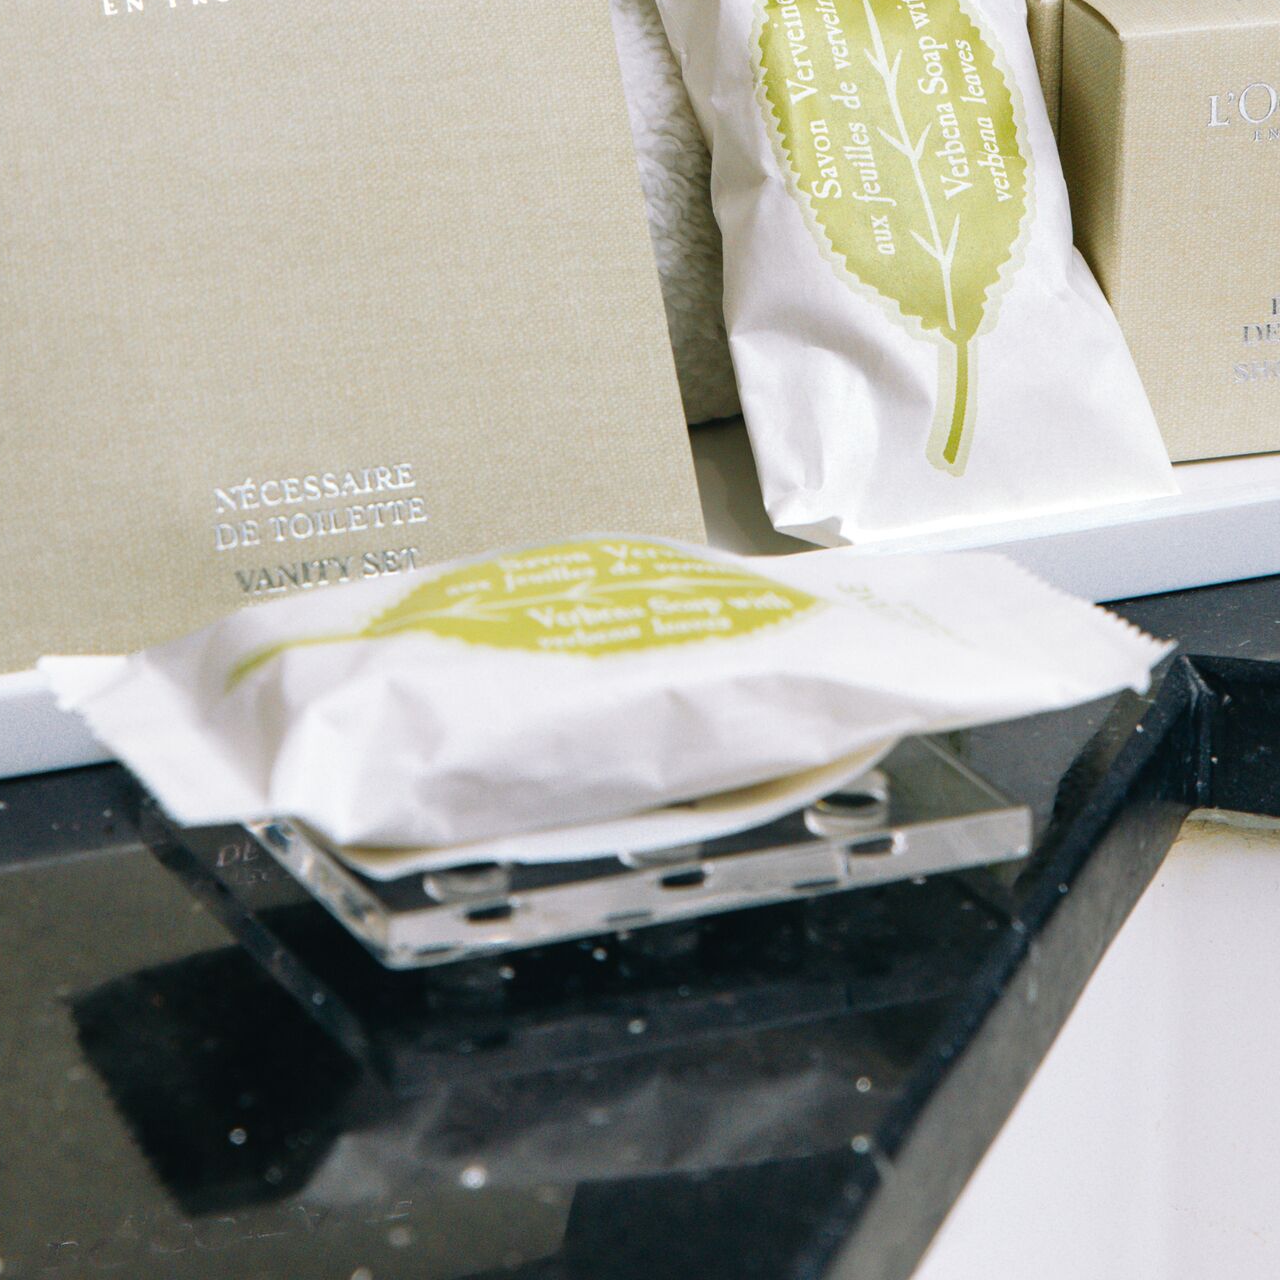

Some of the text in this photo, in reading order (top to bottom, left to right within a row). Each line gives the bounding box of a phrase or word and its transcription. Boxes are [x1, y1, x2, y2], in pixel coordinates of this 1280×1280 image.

[917, 35, 949, 95] Soap
[831, 81, 861, 110] de
[955, 38, 1013, 203] verbena leaves
[809, 119, 842, 199] Savon
[935, 102, 973, 200] Verbena
[1253, 127, 1280, 142] EN
[839, 120, 898, 207] feuilles
[870, 215, 896, 256] aux
[213, 463, 417, 514] NÉCESSAIRE
[215, 496, 428, 552] DE TOILETTE
[235, 546, 419, 596] VANITY SET
